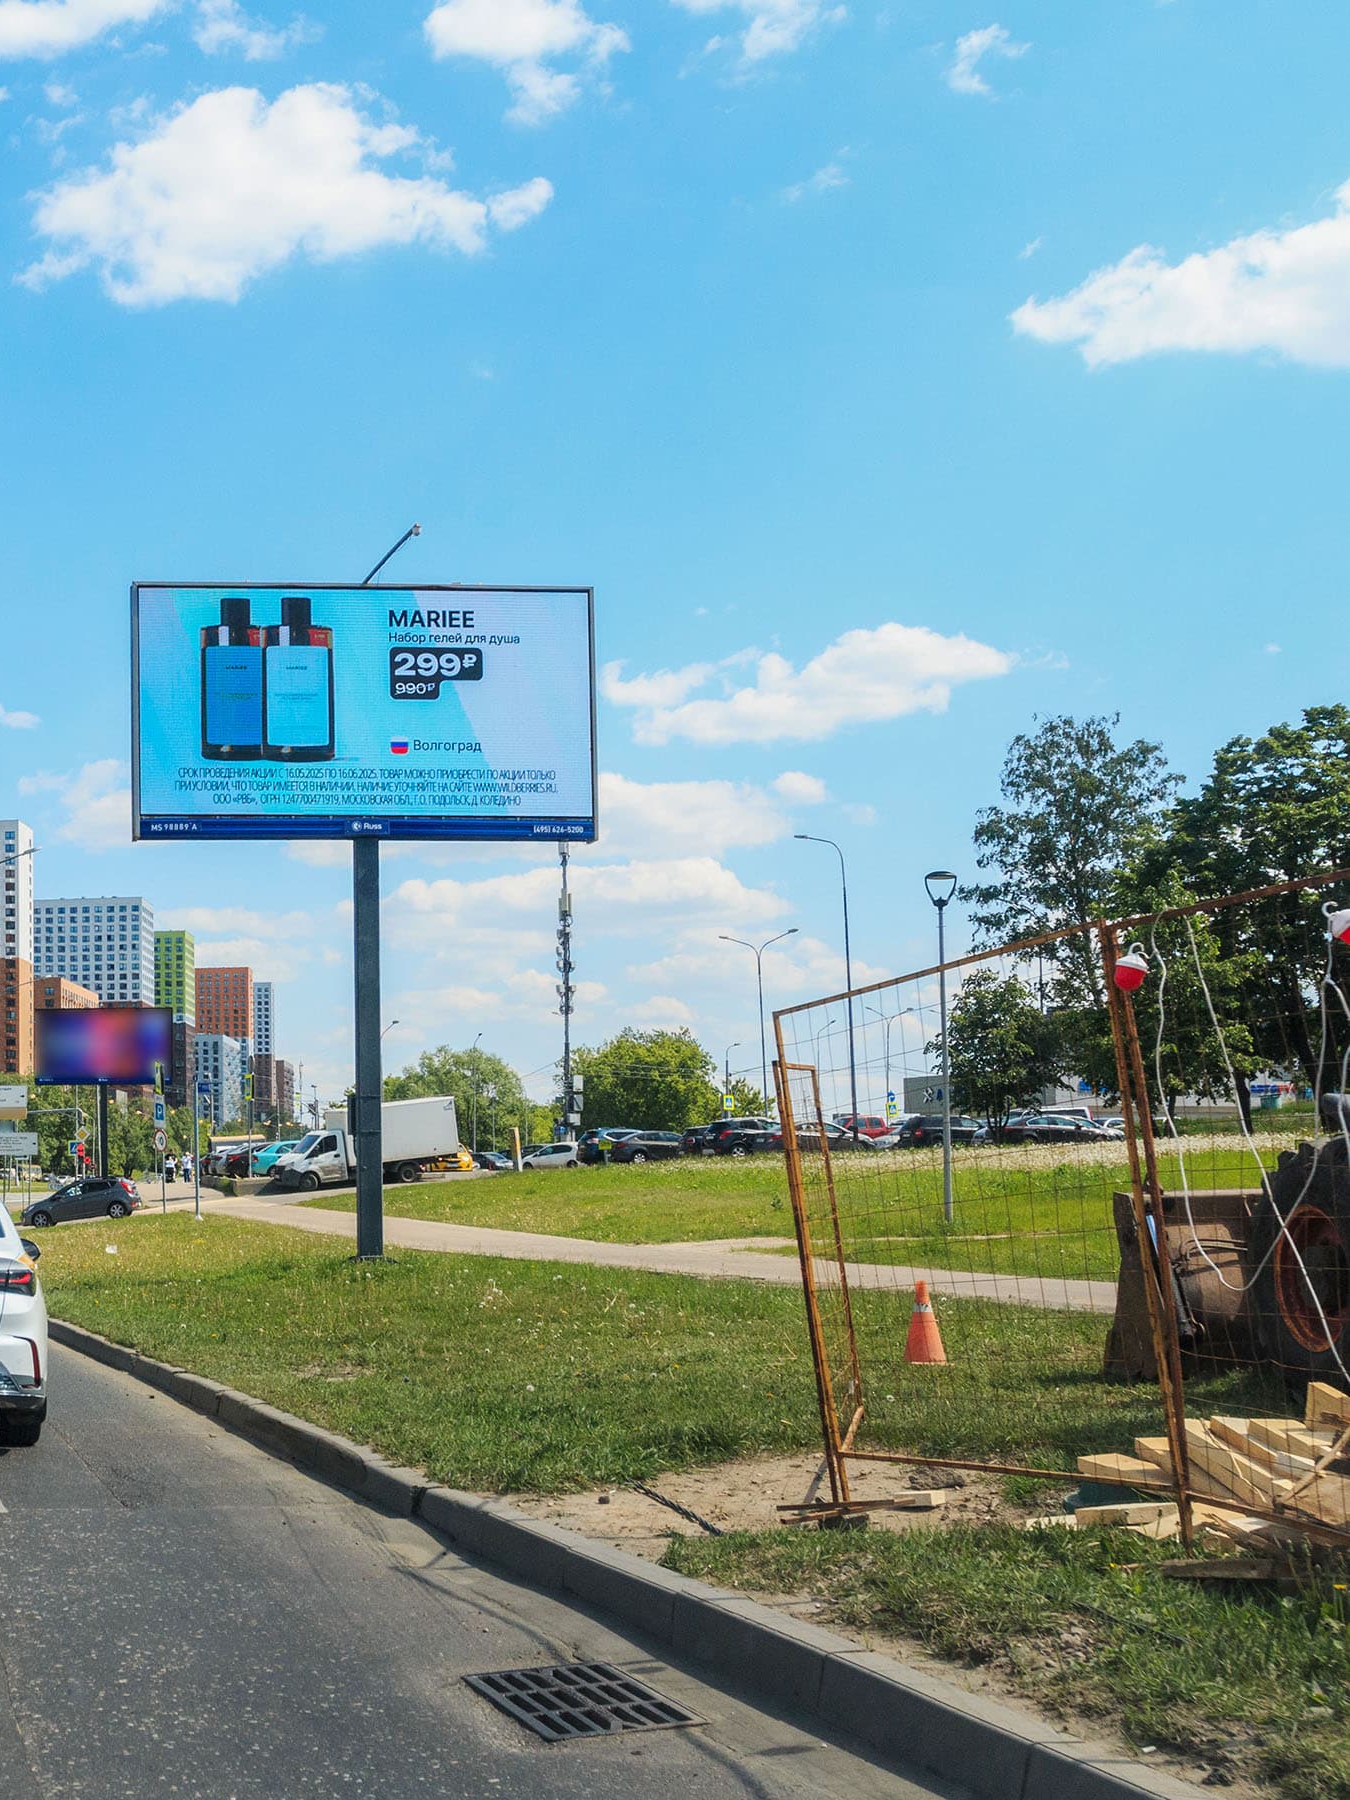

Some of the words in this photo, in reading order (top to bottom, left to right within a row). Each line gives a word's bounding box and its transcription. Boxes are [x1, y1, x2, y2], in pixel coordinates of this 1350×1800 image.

[389, 610, 475, 628] MARIEE
[389, 632, 426, 644] Набор
[428, 633, 462, 644] гелей
[464, 635, 487, 644] для
[489, 635, 520, 646] душа
[413, 740, 482, 753] Волгоград
[178, 767, 198, 778] СРОК
[199, 768, 250, 779] ПРОВЕДЕНИЯ
[251, 768, 277, 779] АКЦИИ
[279, 768, 284, 778] С
[325, 768, 337, 779] ПО
[379, 768, 403, 779] ТОВАР
[404, 769, 436, 779] МОЖНО
[436, 769, 486, 780] ПРИОБРЕСТИ
[487, 769, 498, 780] ПО
[499, 769, 526, 781] АКЦИИ
[527, 769, 556, 780] ТОЛЬКО
[174, 780, 191, 791] ПРИ
[232, 781, 247, 791] ЧТО
[248, 781, 272, 791] ТОВАР
[273, 781, 308, 791] ИМЕЕТСЯ
[310, 781, 315, 791] В
[393, 780, 437, 792] УТОЧНЯЙТЕ
[438, 782, 449, 792] НА
[450, 780, 472, 793] САЙТЕ
[213, 794, 231, 804] ООО
[260, 794, 280, 804] ОГРН
[341, 794, 393, 805] МОСКОВСКАЯ
[480, 795, 521, 806] КОЛЕДИНО
[151, 823, 163, 831] MS
[363, 822, 382, 830] Russ
[533, 825, 551, 834] (495)
[552, 825, 584, 834] 626-5200
